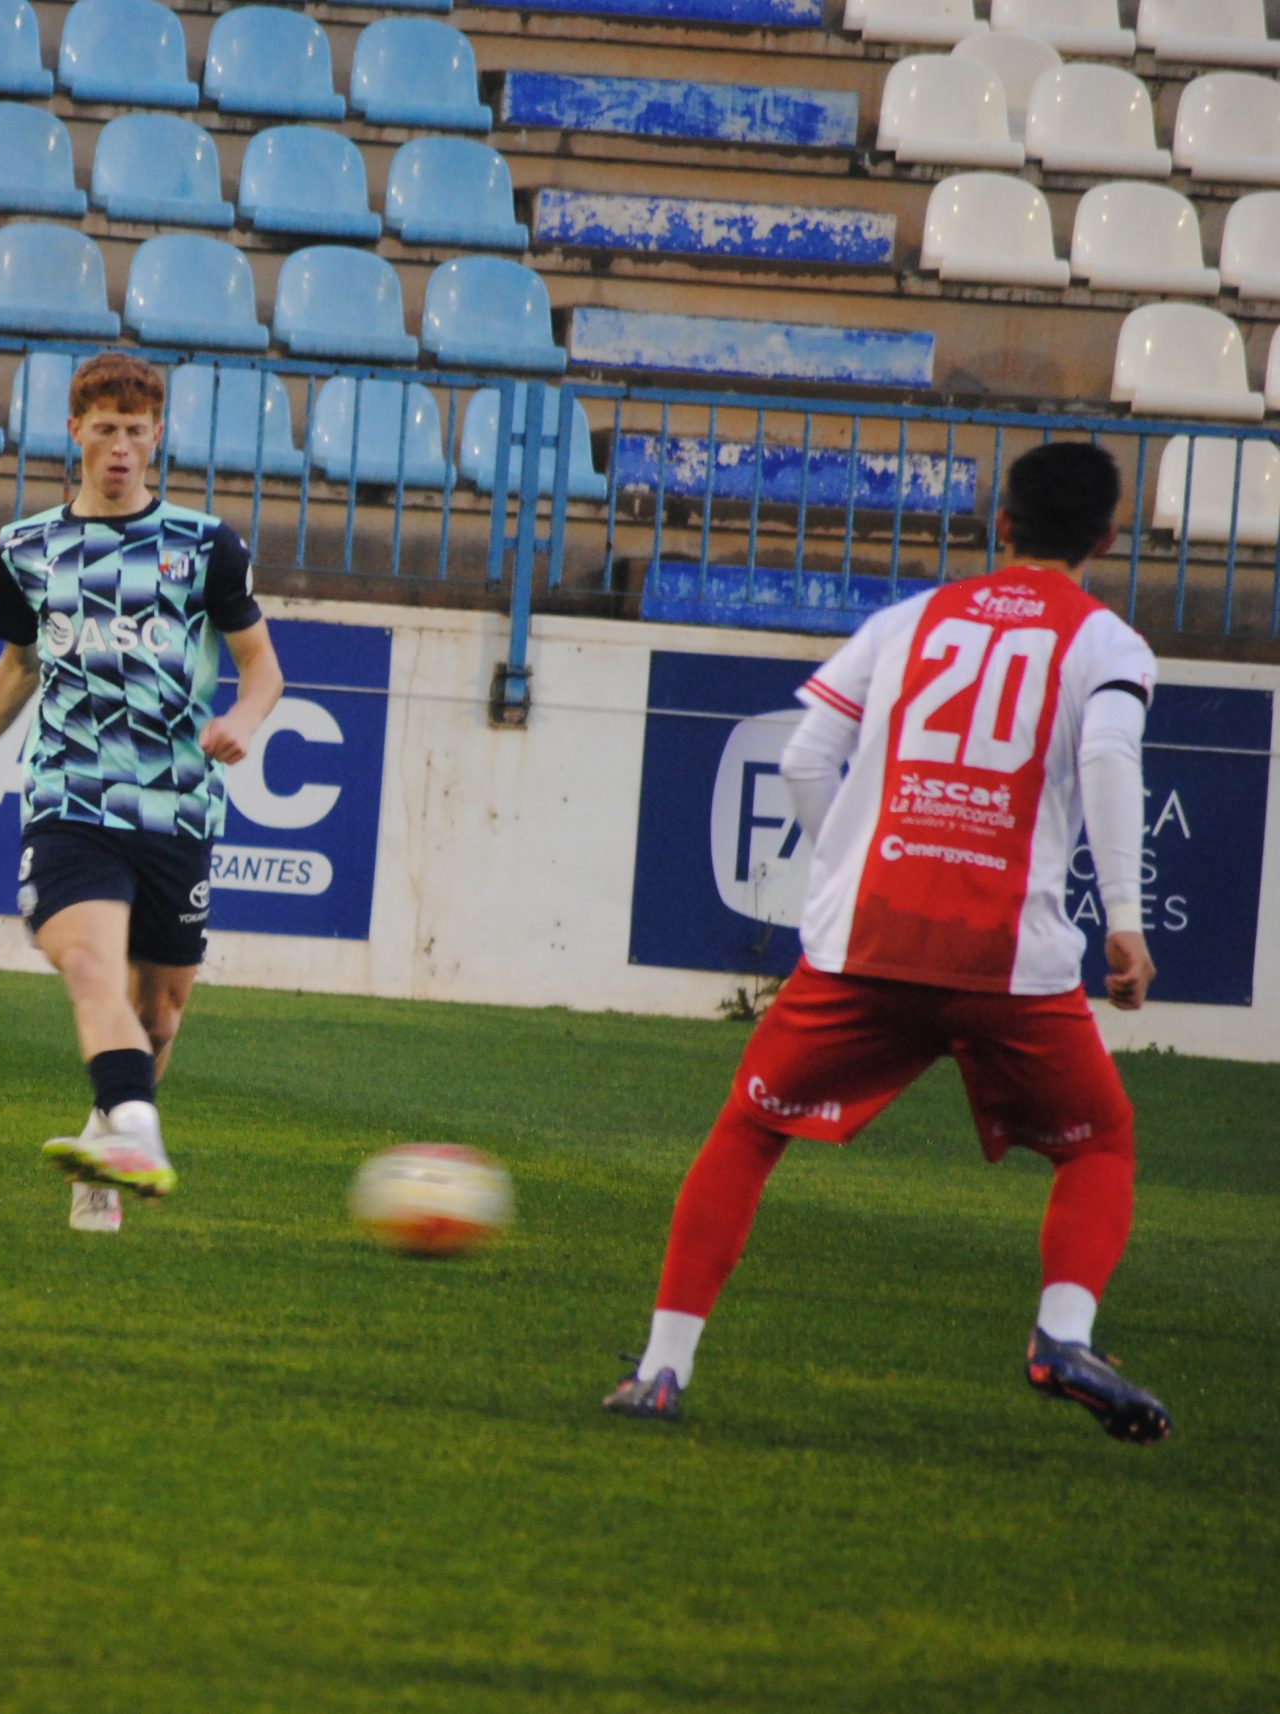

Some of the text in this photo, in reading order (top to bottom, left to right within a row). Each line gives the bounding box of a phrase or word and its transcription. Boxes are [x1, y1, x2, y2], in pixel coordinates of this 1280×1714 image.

[75, 615, 171, 656] ASC
[896, 617, 1058, 774] 20
[889, 795, 910, 813] La
[912, 797, 1017, 830] Misericordia
